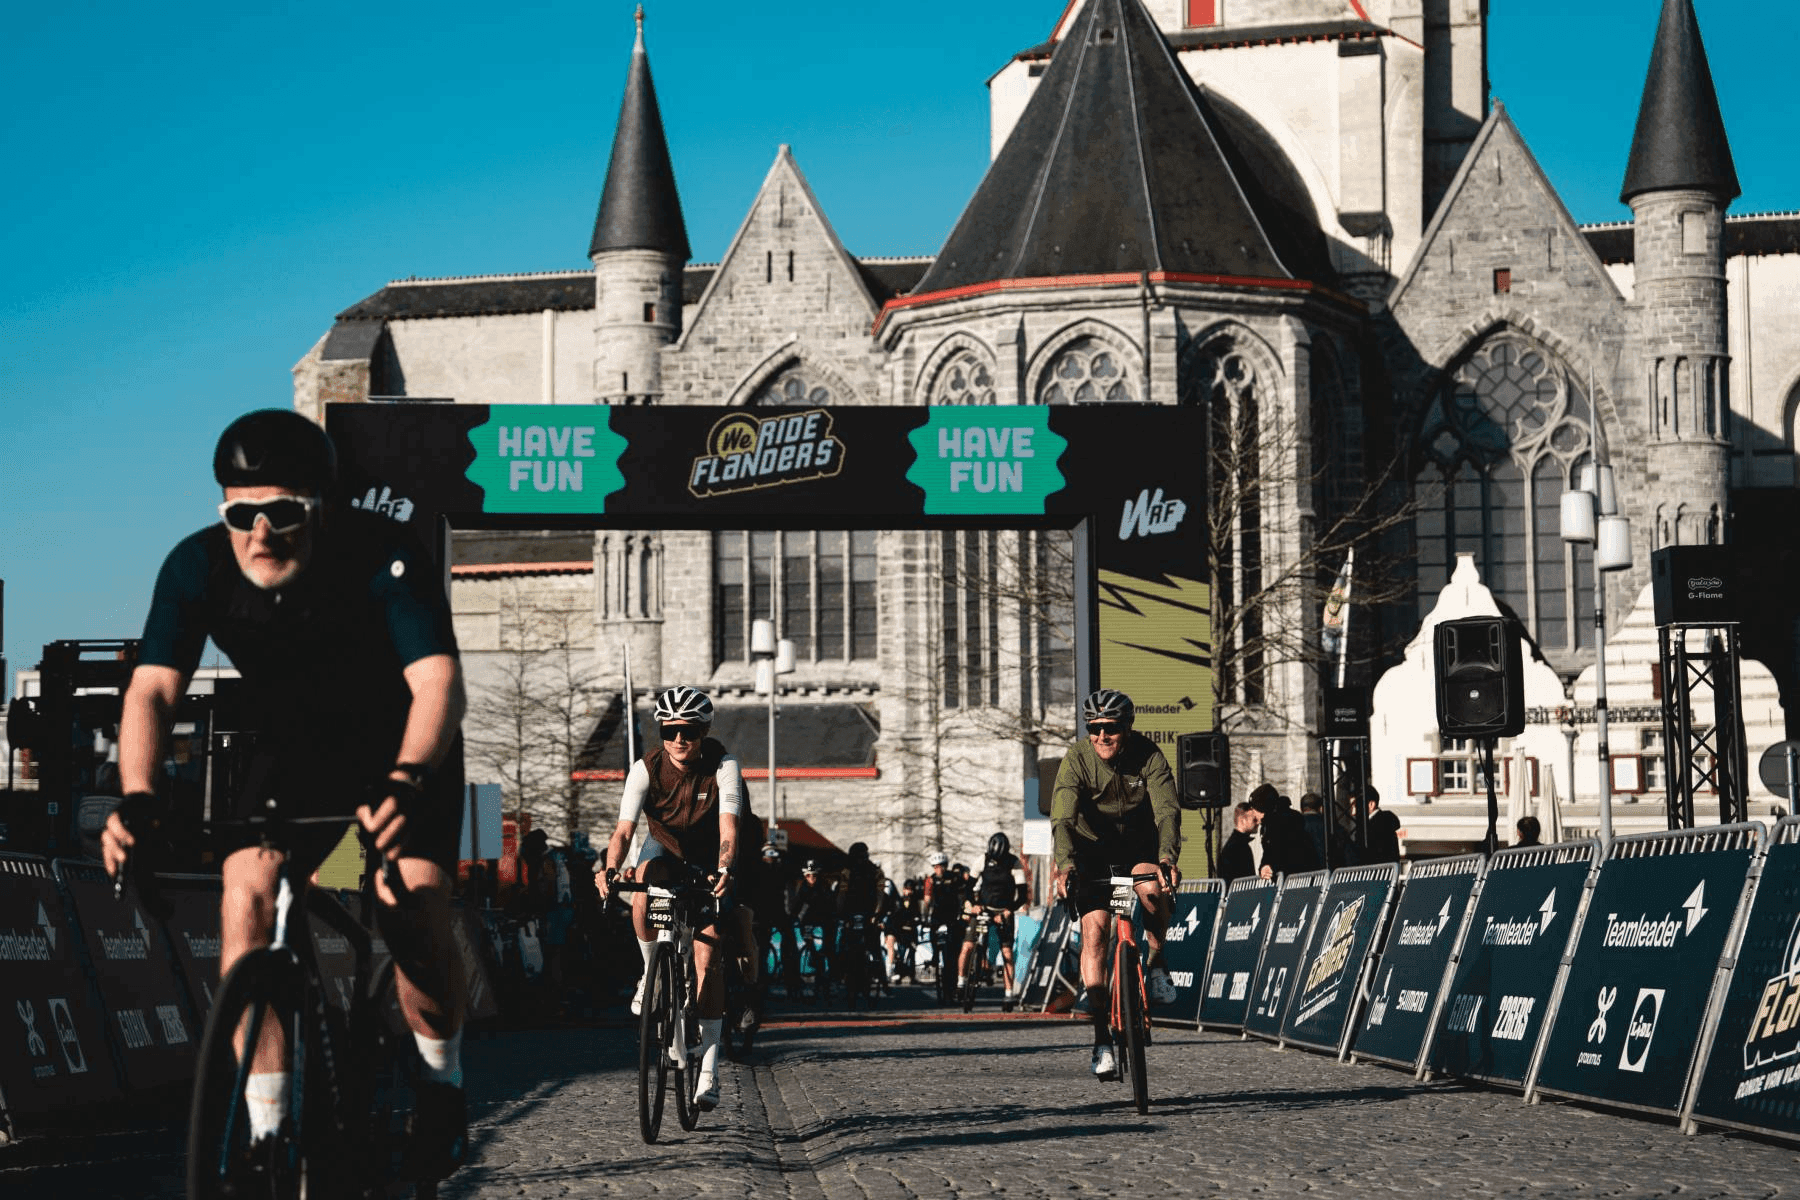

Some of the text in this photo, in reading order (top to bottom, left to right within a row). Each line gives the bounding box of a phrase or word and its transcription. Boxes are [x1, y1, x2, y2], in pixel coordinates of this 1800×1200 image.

[498, 426, 596, 457] HAVE
[721, 413, 821, 452] We RIDE
[938, 426, 1035, 458] HAVE
[509, 460, 583, 492] FUN
[950, 461, 1023, 493] FUN
[1134, 704, 1181, 714] mleader
[1481, 915, 1539, 945] Teamleader
[1602, 912, 1682, 948] Teamleader
